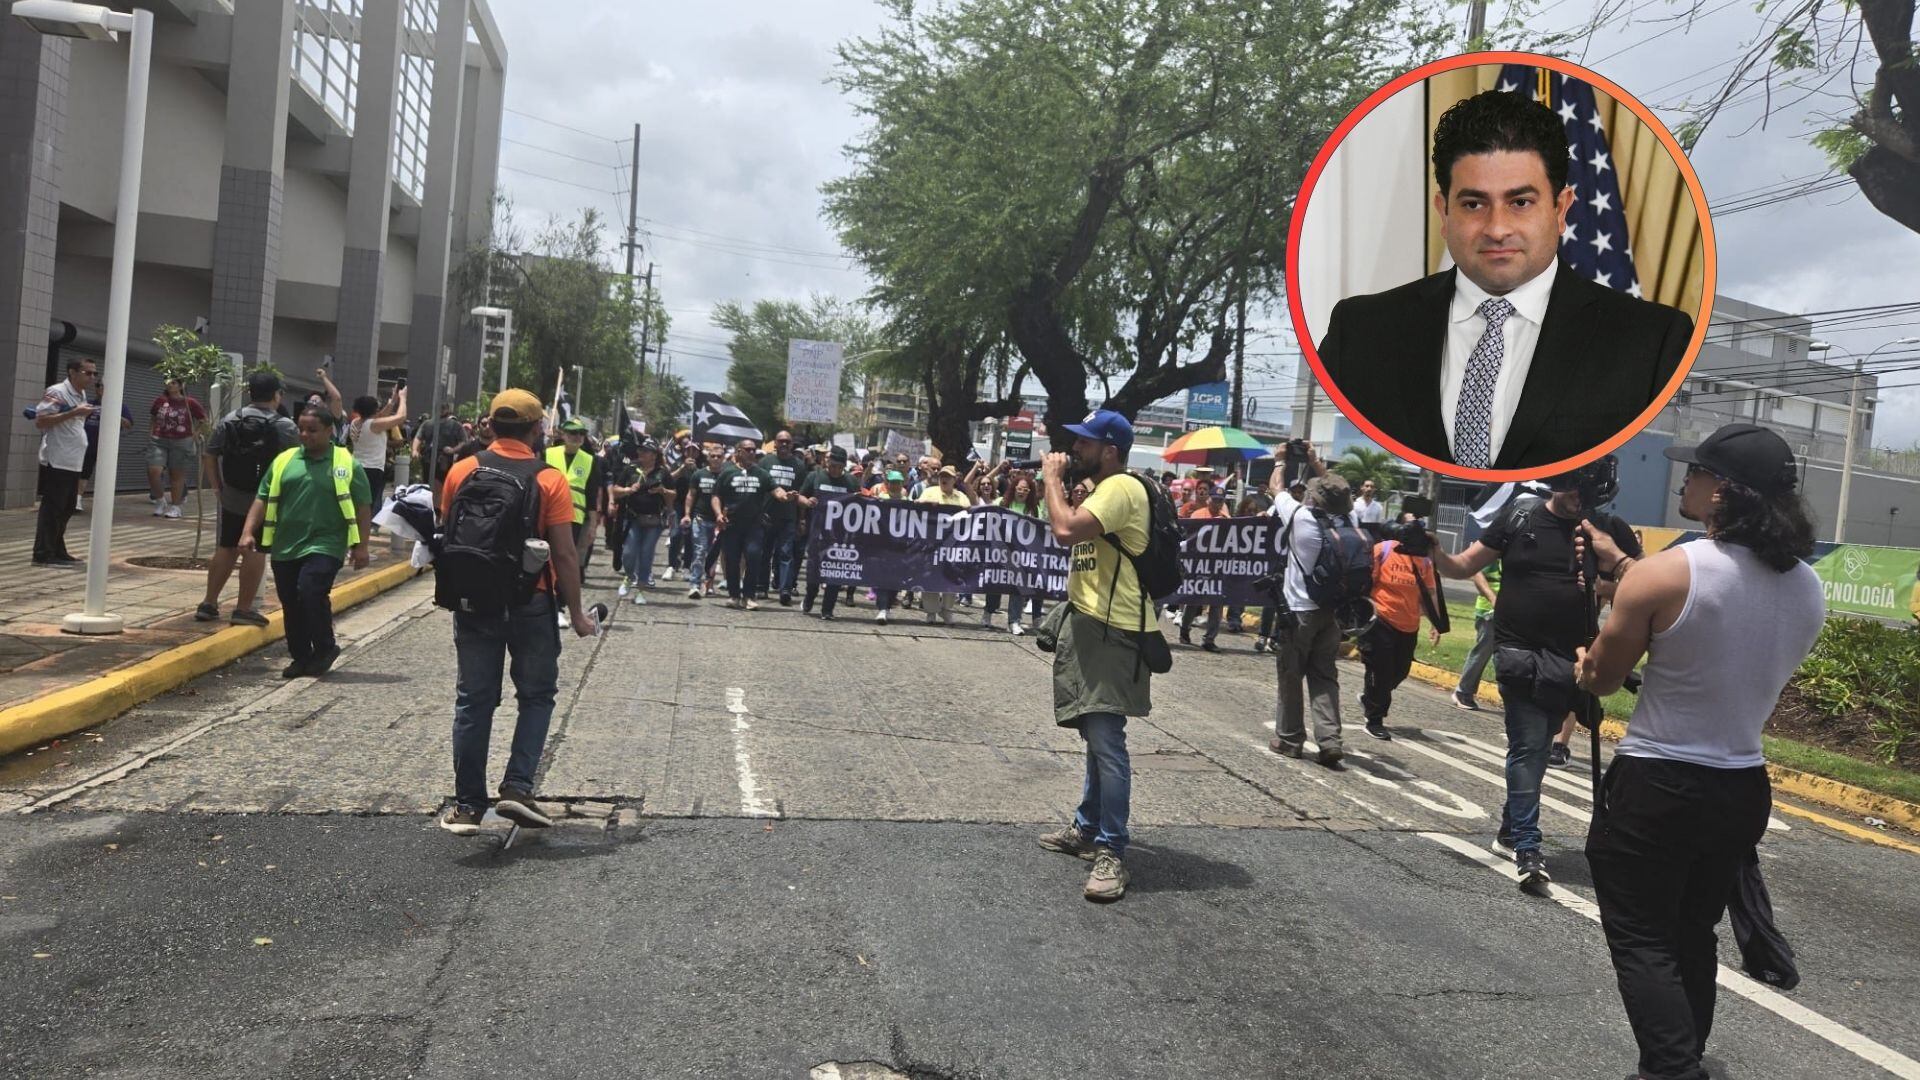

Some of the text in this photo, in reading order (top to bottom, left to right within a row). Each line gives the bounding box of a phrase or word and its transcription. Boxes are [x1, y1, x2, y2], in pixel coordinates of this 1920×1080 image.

[825, 500, 881, 535] POR
[889, 507, 928, 539] UN
[936, 511, 1037, 546] PUERTO
[1196, 525, 1268, 554] CLASE
[933, 546, 1070, 571] ¡FUERA LOS QUE TRA
[1195, 559, 1211, 575] AL
[1214, 559, 1269, 576] PUEBLO!
[820, 569, 862, 580] SINDICAL
[978, 569, 1024, 588] ¡FUERA
[1027, 574, 1043, 589] LA
[1820, 580, 1895, 608] CNOLOGÍA
